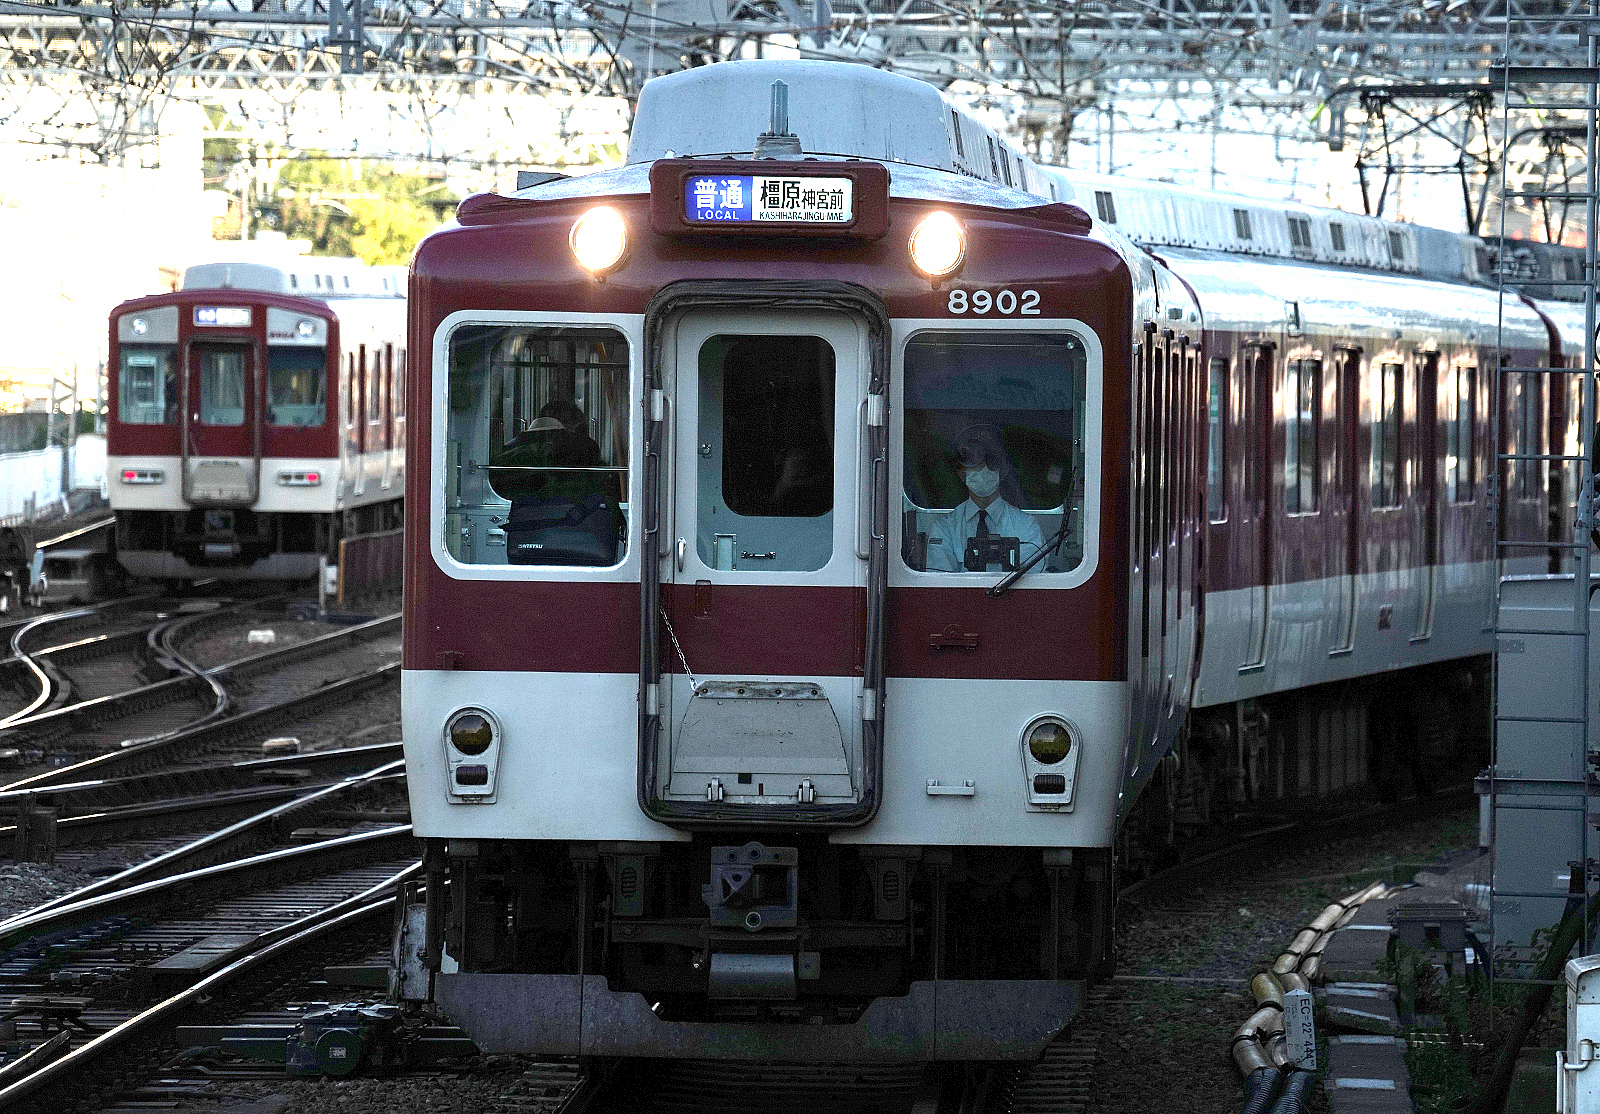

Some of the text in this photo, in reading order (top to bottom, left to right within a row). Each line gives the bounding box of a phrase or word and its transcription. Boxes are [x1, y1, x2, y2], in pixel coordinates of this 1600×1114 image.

[694, 179, 744, 209] 普通
[760, 180, 844, 210] 橿原神宮前
[698, 210, 739, 220] LOCAL
[948, 289, 1041, 315] 8902
